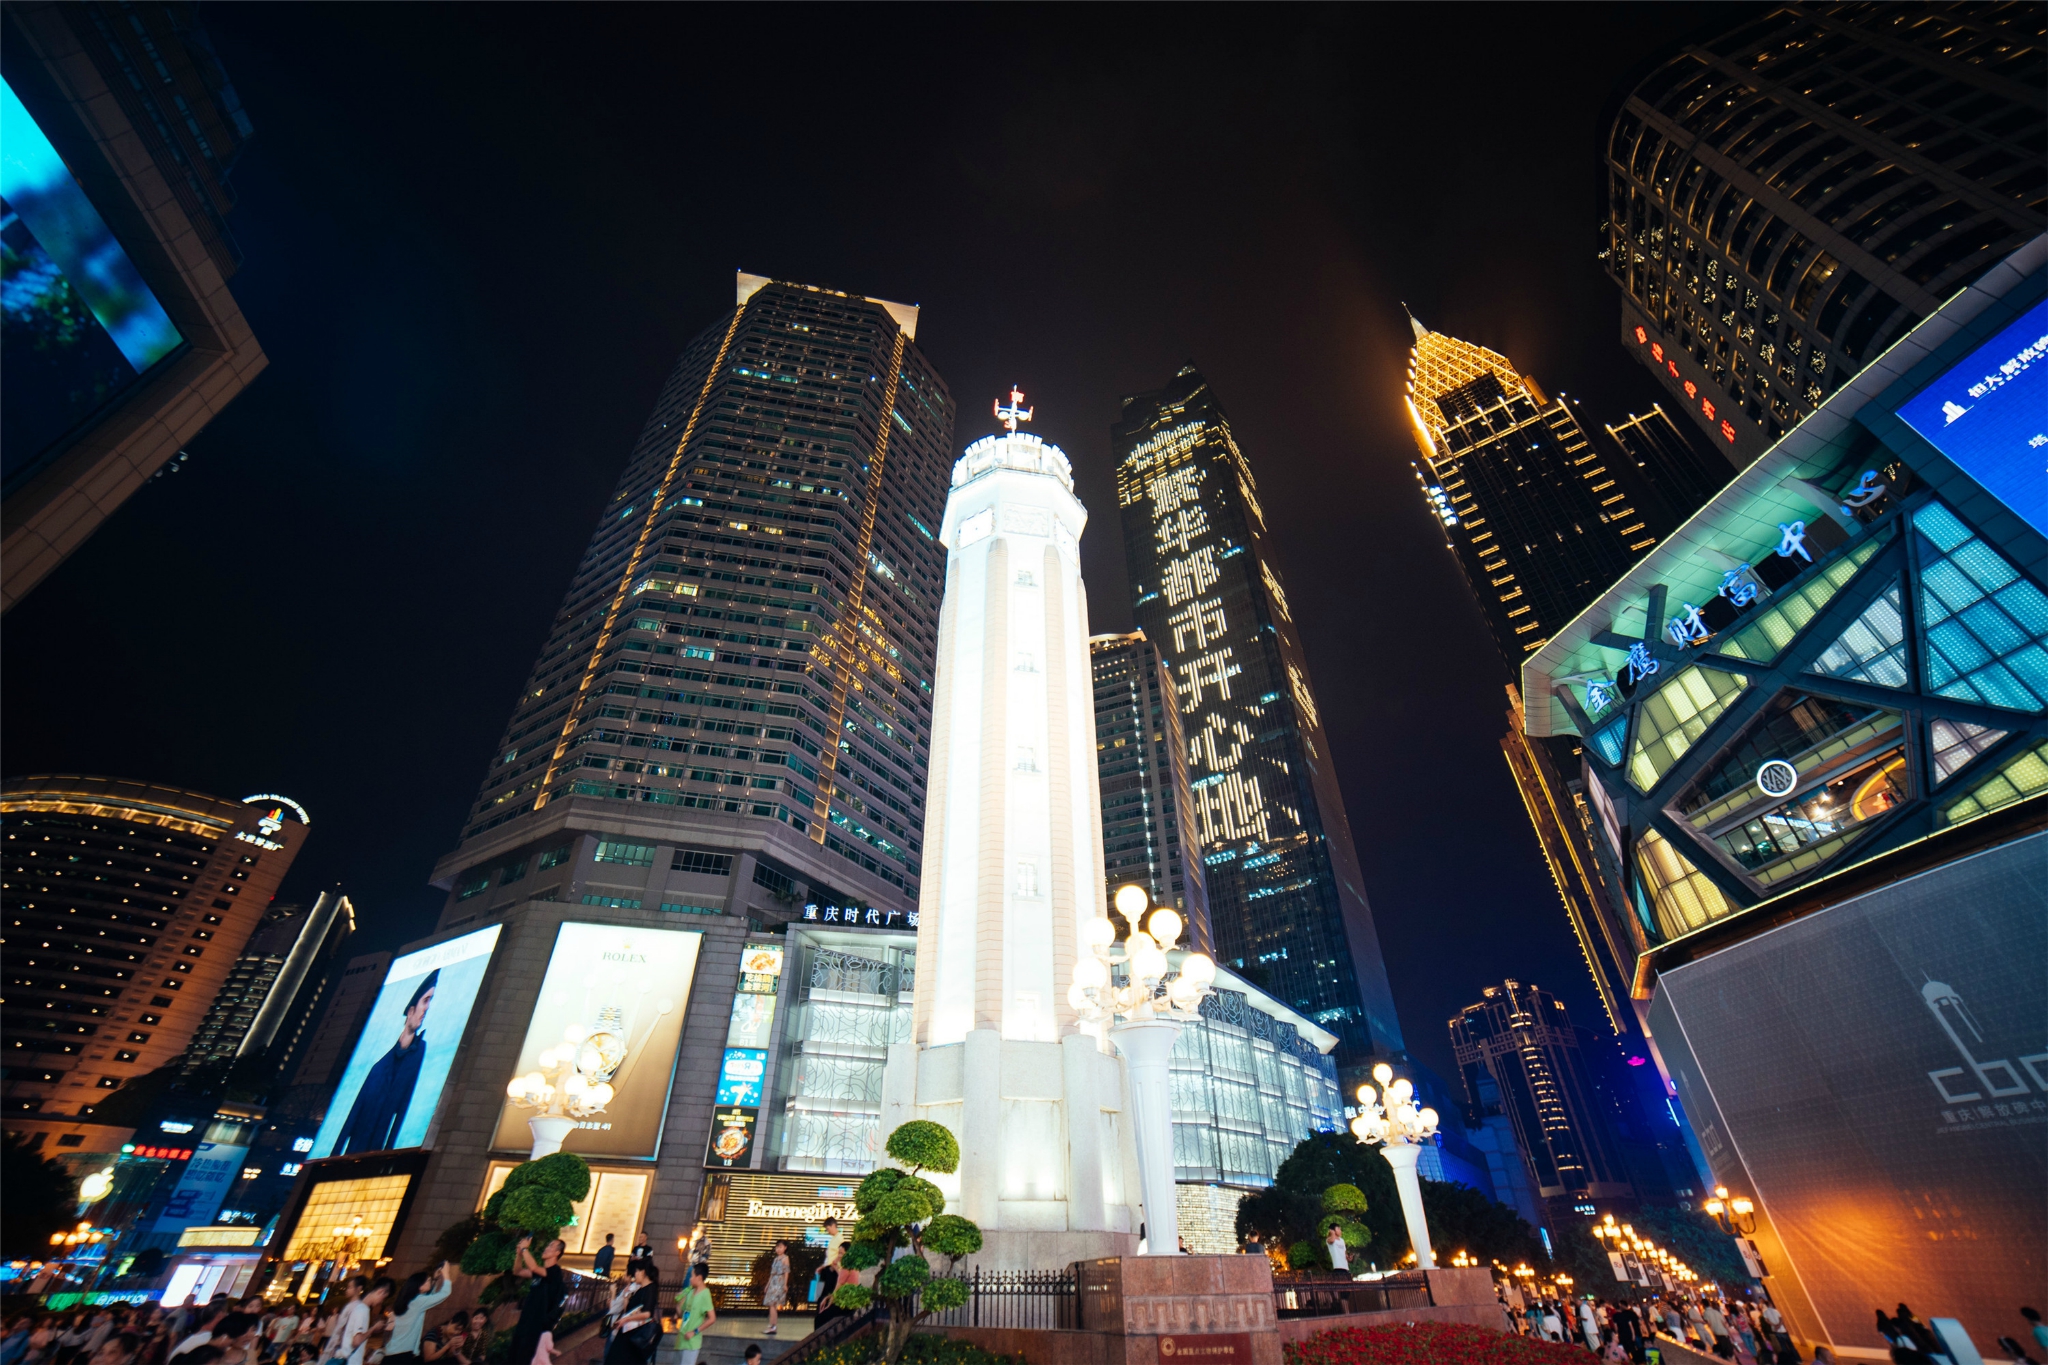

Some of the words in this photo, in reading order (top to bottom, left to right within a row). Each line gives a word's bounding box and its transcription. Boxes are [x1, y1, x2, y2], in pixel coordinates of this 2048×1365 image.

[1585, 470, 1886, 713] 金鹰财富中心
[803, 904, 920, 927] 重庆时代广场
[602, 951, 647, 963] ROLEX
[746, 1200, 841, 1223] Ermenegildo
